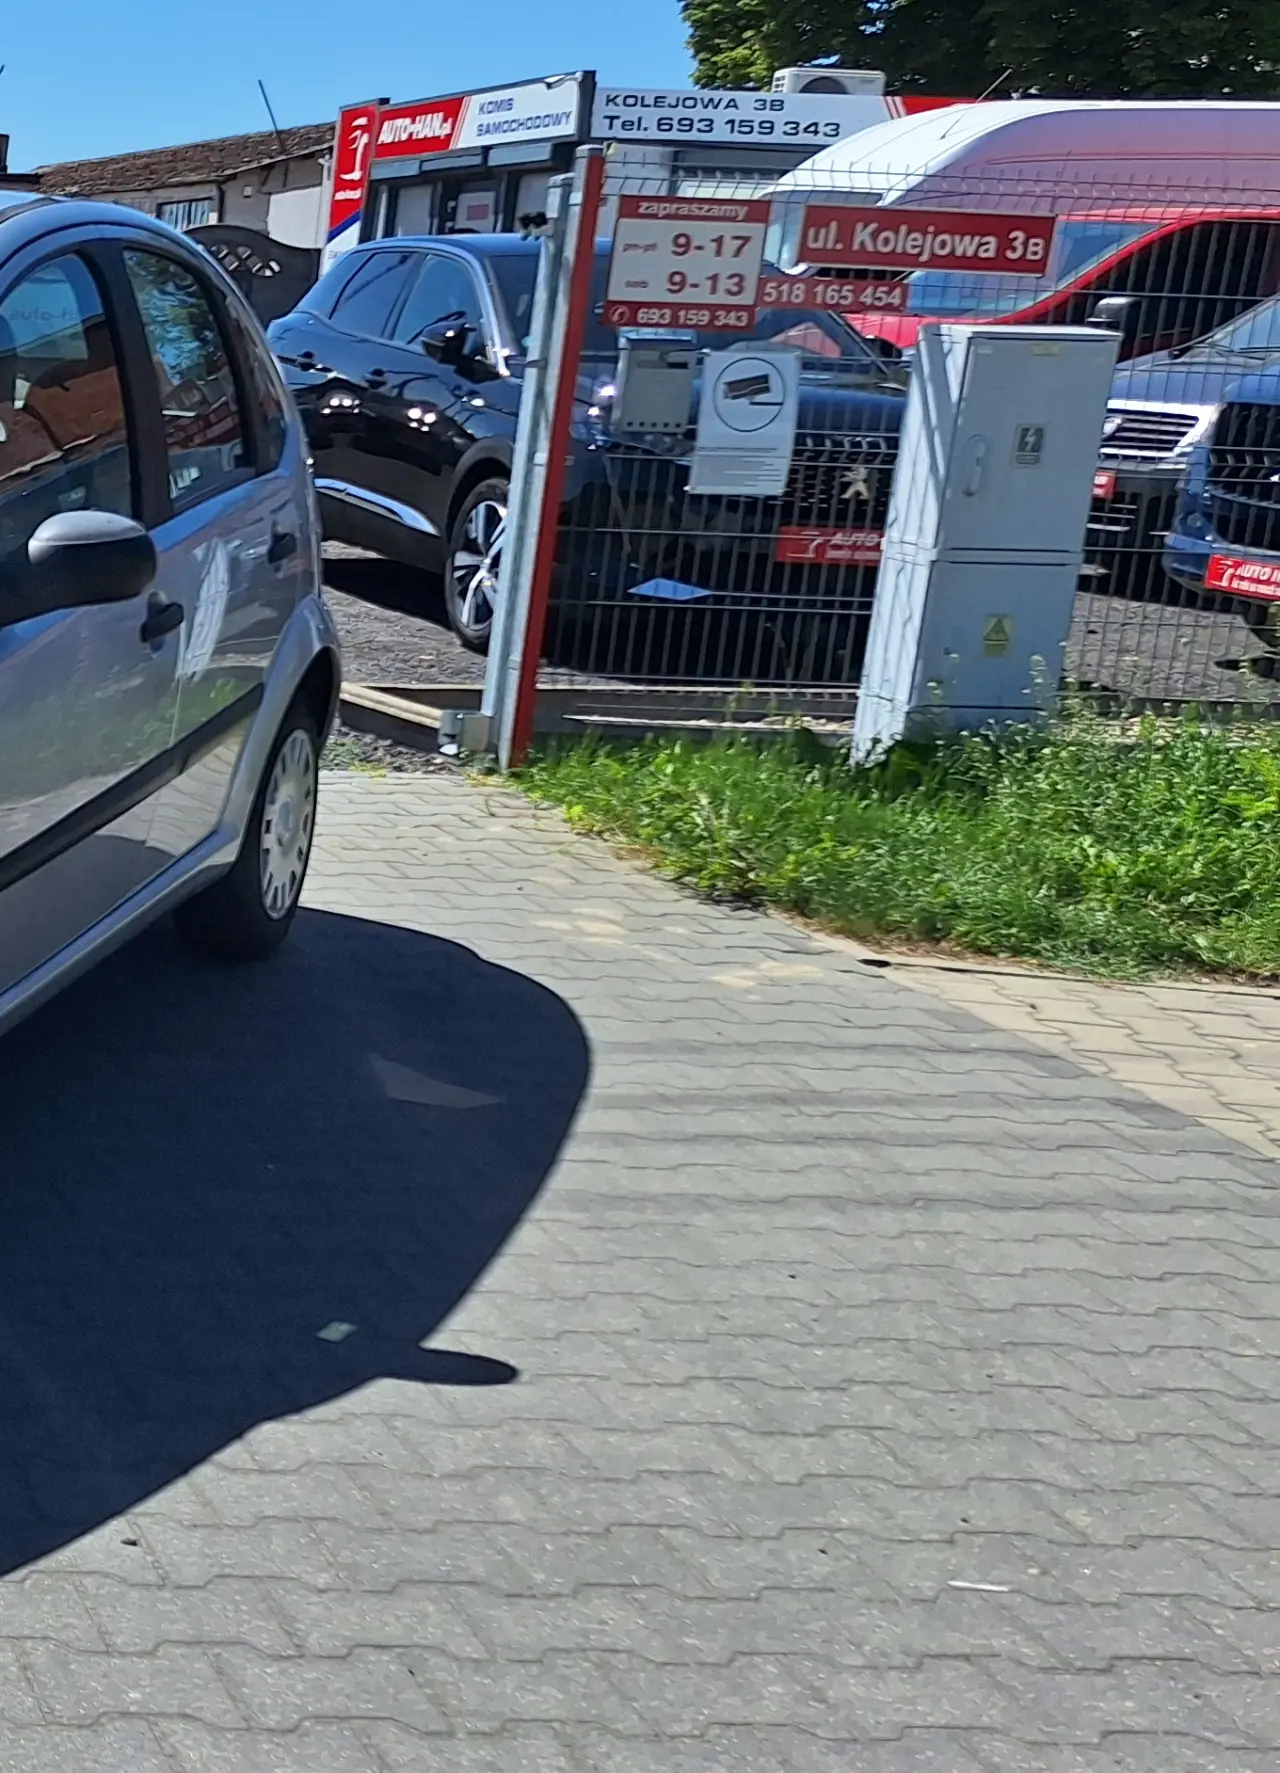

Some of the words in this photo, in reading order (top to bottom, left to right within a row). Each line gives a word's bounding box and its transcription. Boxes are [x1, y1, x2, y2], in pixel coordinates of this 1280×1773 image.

[478, 98, 514, 115] KOMIS
[604, 94, 740, 111] KOLEJOWA
[752, 98, 785, 112] 3B
[476, 111, 573, 137] SAMOCHODOWY
[602, 115, 649, 132] Tel.
[656, 117, 714, 133] 693
[724, 119, 775, 135] 159
[782, 121, 841, 138] 343
[637, 201, 749, 220] zapraszamy
[671, 233, 752, 258] 9-17
[806, 220, 844, 250] ul.
[851, 221, 999, 263] Kolejowa
[1004, 230, 1046, 261] 3B
[666, 270, 746, 297] 9-13
[762, 281, 806, 303] 518
[811, 283, 855, 305] 165
[858, 285, 903, 307] 454
[636, 308, 672, 325] 693
[676, 310, 710, 326] 159
[713, 311, 749, 327] 343
